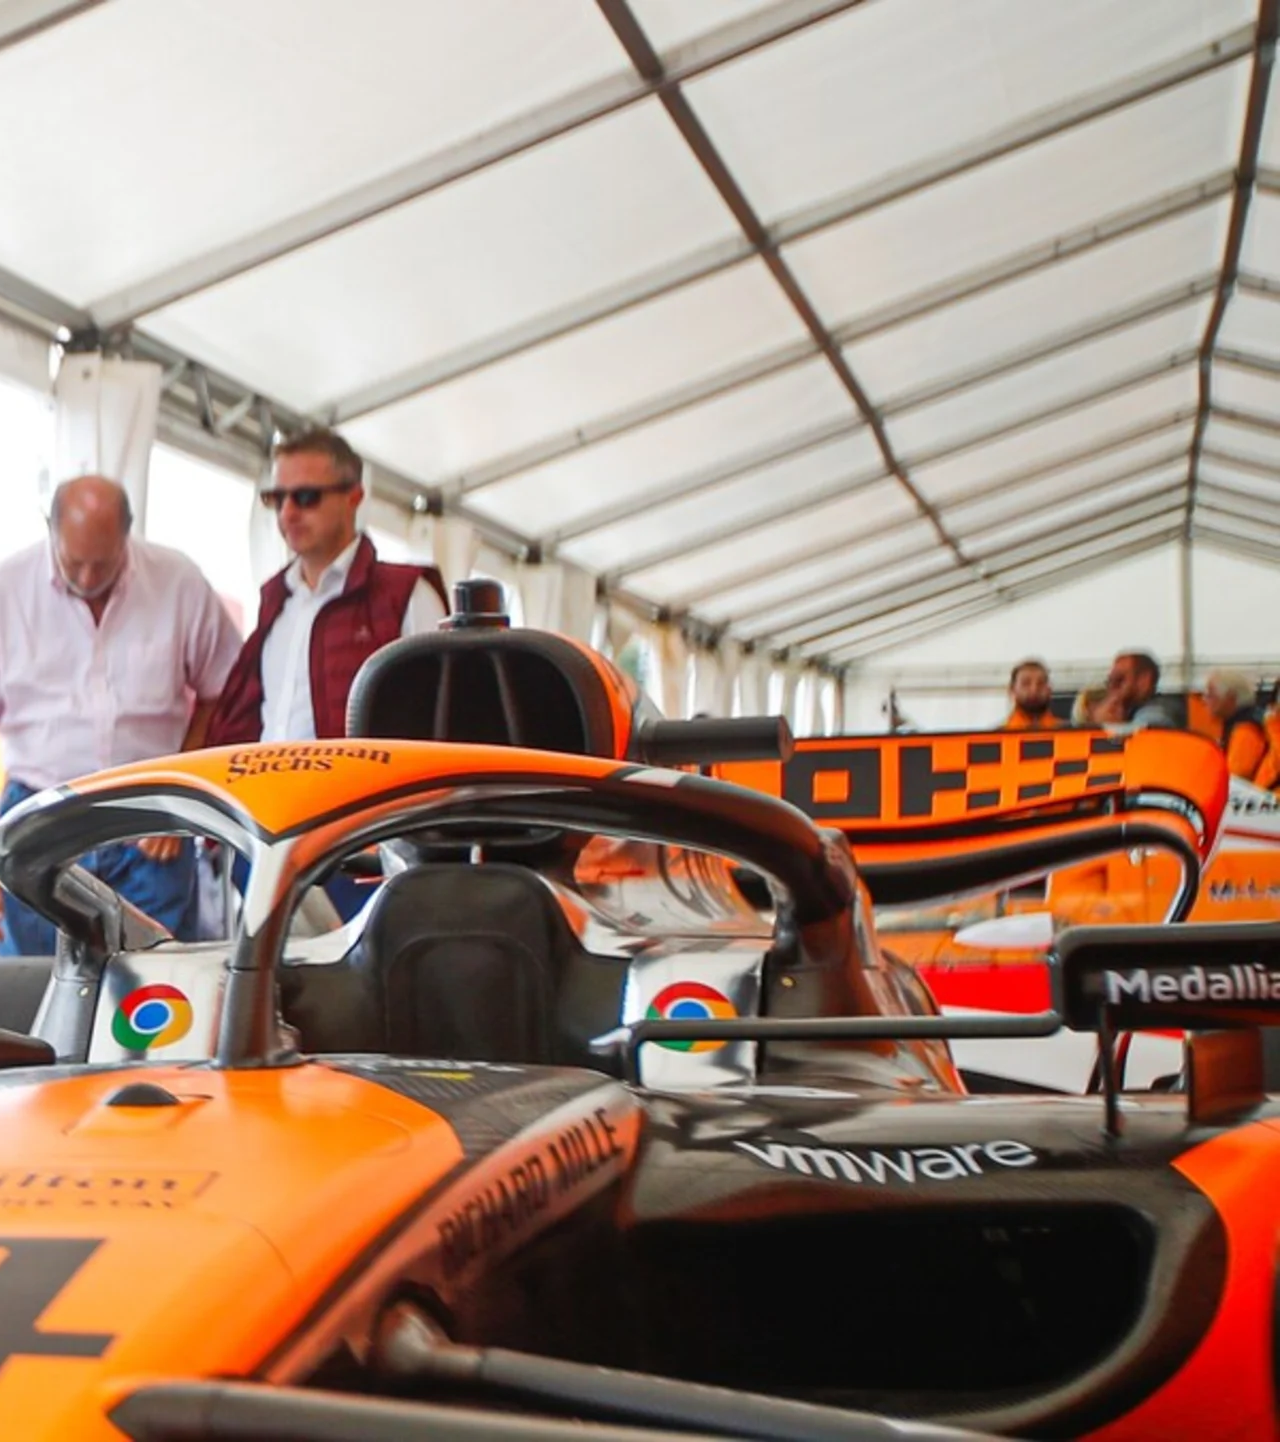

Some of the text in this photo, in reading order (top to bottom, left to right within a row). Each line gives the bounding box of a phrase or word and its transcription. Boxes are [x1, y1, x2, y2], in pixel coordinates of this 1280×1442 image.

[226, 757, 332, 784] Sachs
[230, 746, 391, 764] Goldman
[733, 1140, 1037, 1184] vmware
[438, 1107, 624, 1276] RICHARD MILLE
